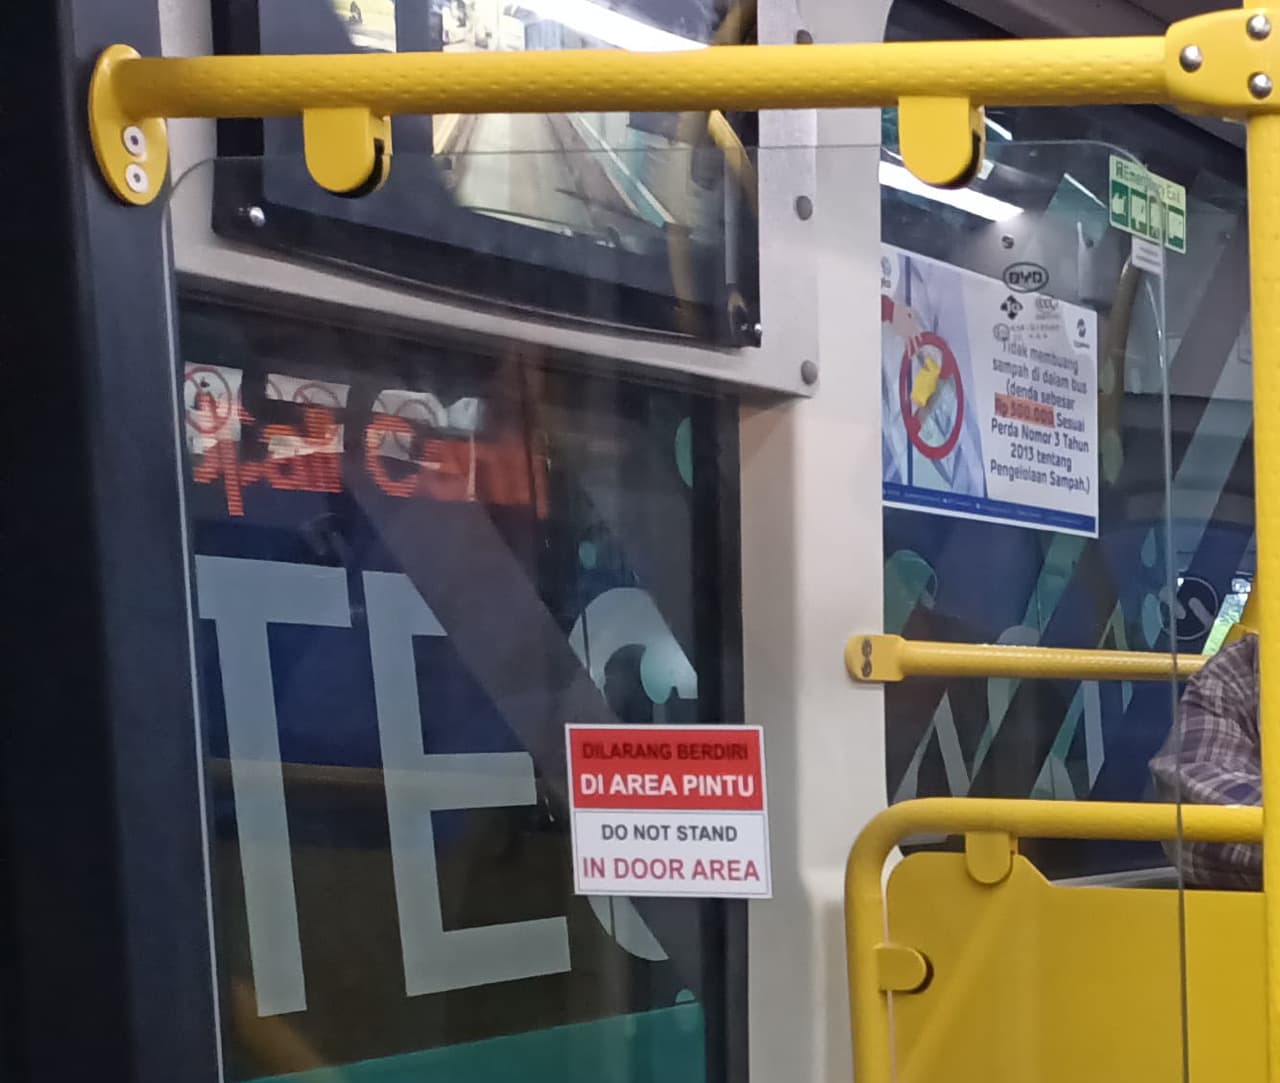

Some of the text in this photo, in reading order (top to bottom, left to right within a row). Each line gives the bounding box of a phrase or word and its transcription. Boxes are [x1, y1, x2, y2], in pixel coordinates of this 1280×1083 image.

[991, 417, 1089, 453] Perda Nomor 3 Tahun
[1010, 442, 1072, 474] 2013 tentang
[582, 743, 748, 761] DILARANG BERDIRI
[580, 774, 754, 797] DI AREA PINTU
[601, 824, 738, 842] DO NOT STAND
[583, 857, 760, 881] IN DOOR AREA
